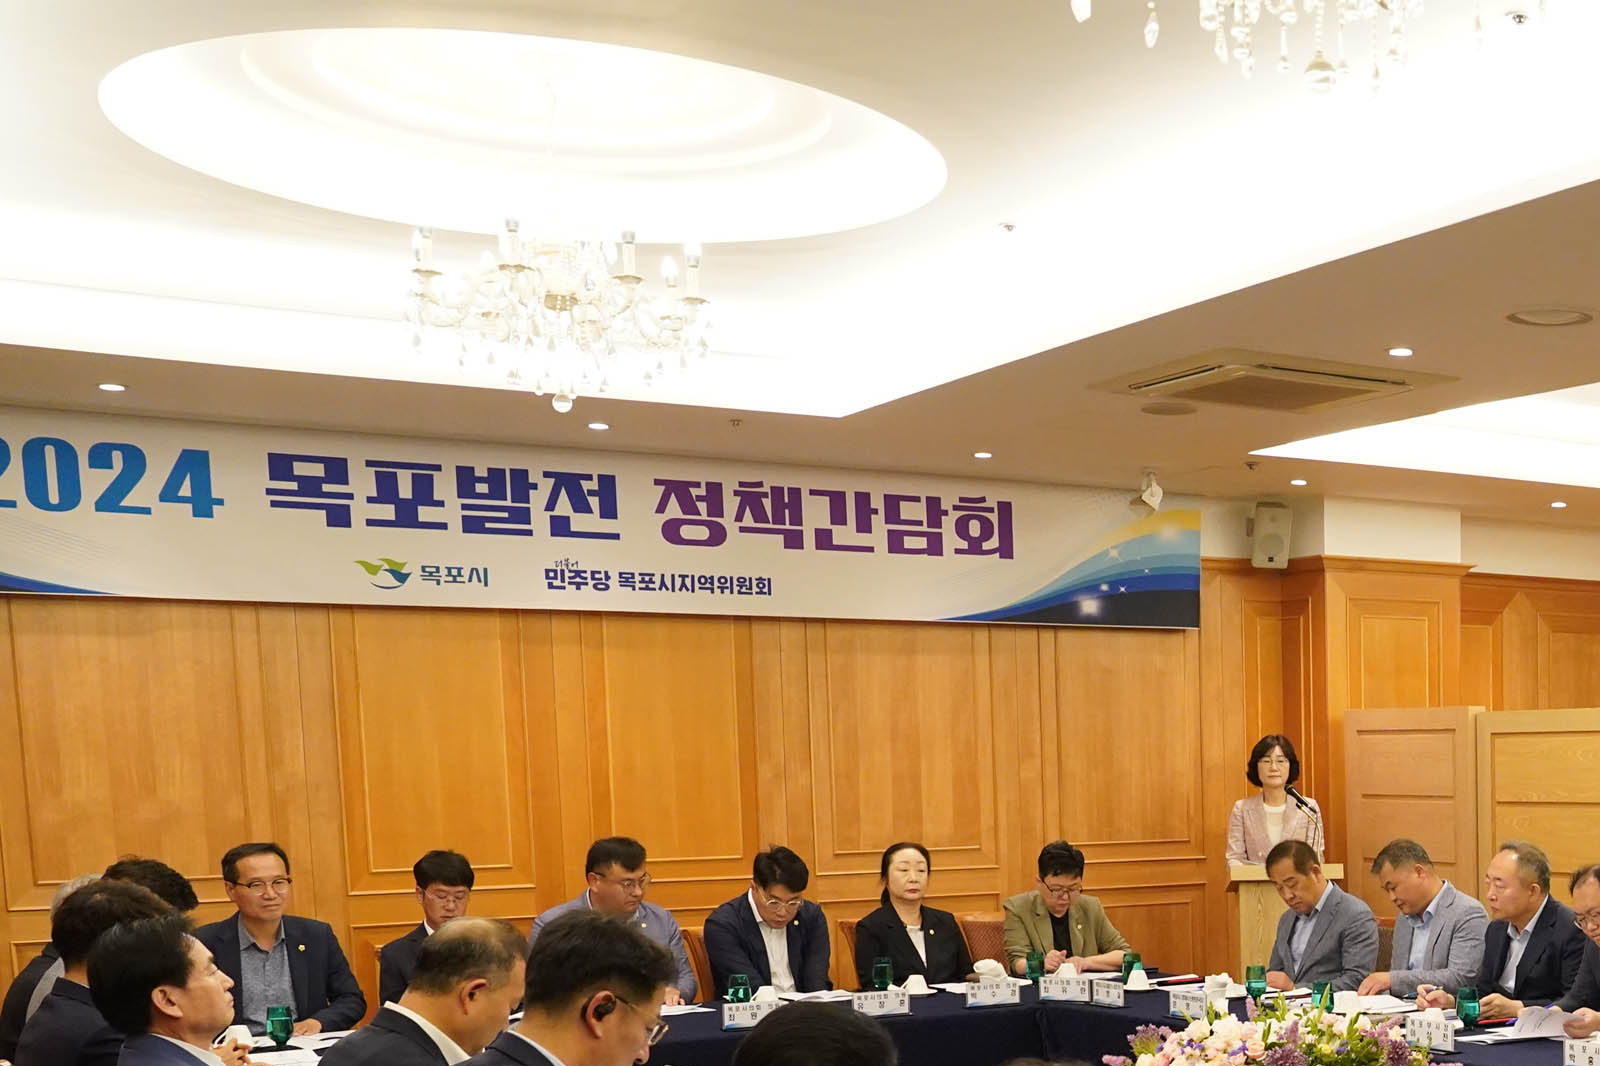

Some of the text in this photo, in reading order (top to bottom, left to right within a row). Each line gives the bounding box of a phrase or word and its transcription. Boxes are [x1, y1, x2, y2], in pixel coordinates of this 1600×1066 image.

[0, 436, 1015, 560] 024 목포발전 정책간담회
[420, 564, 489, 587] 목포시
[554, 558, 579, 569] 더불어
[544, 568, 773, 596] 민주당 목포시지역위원회
